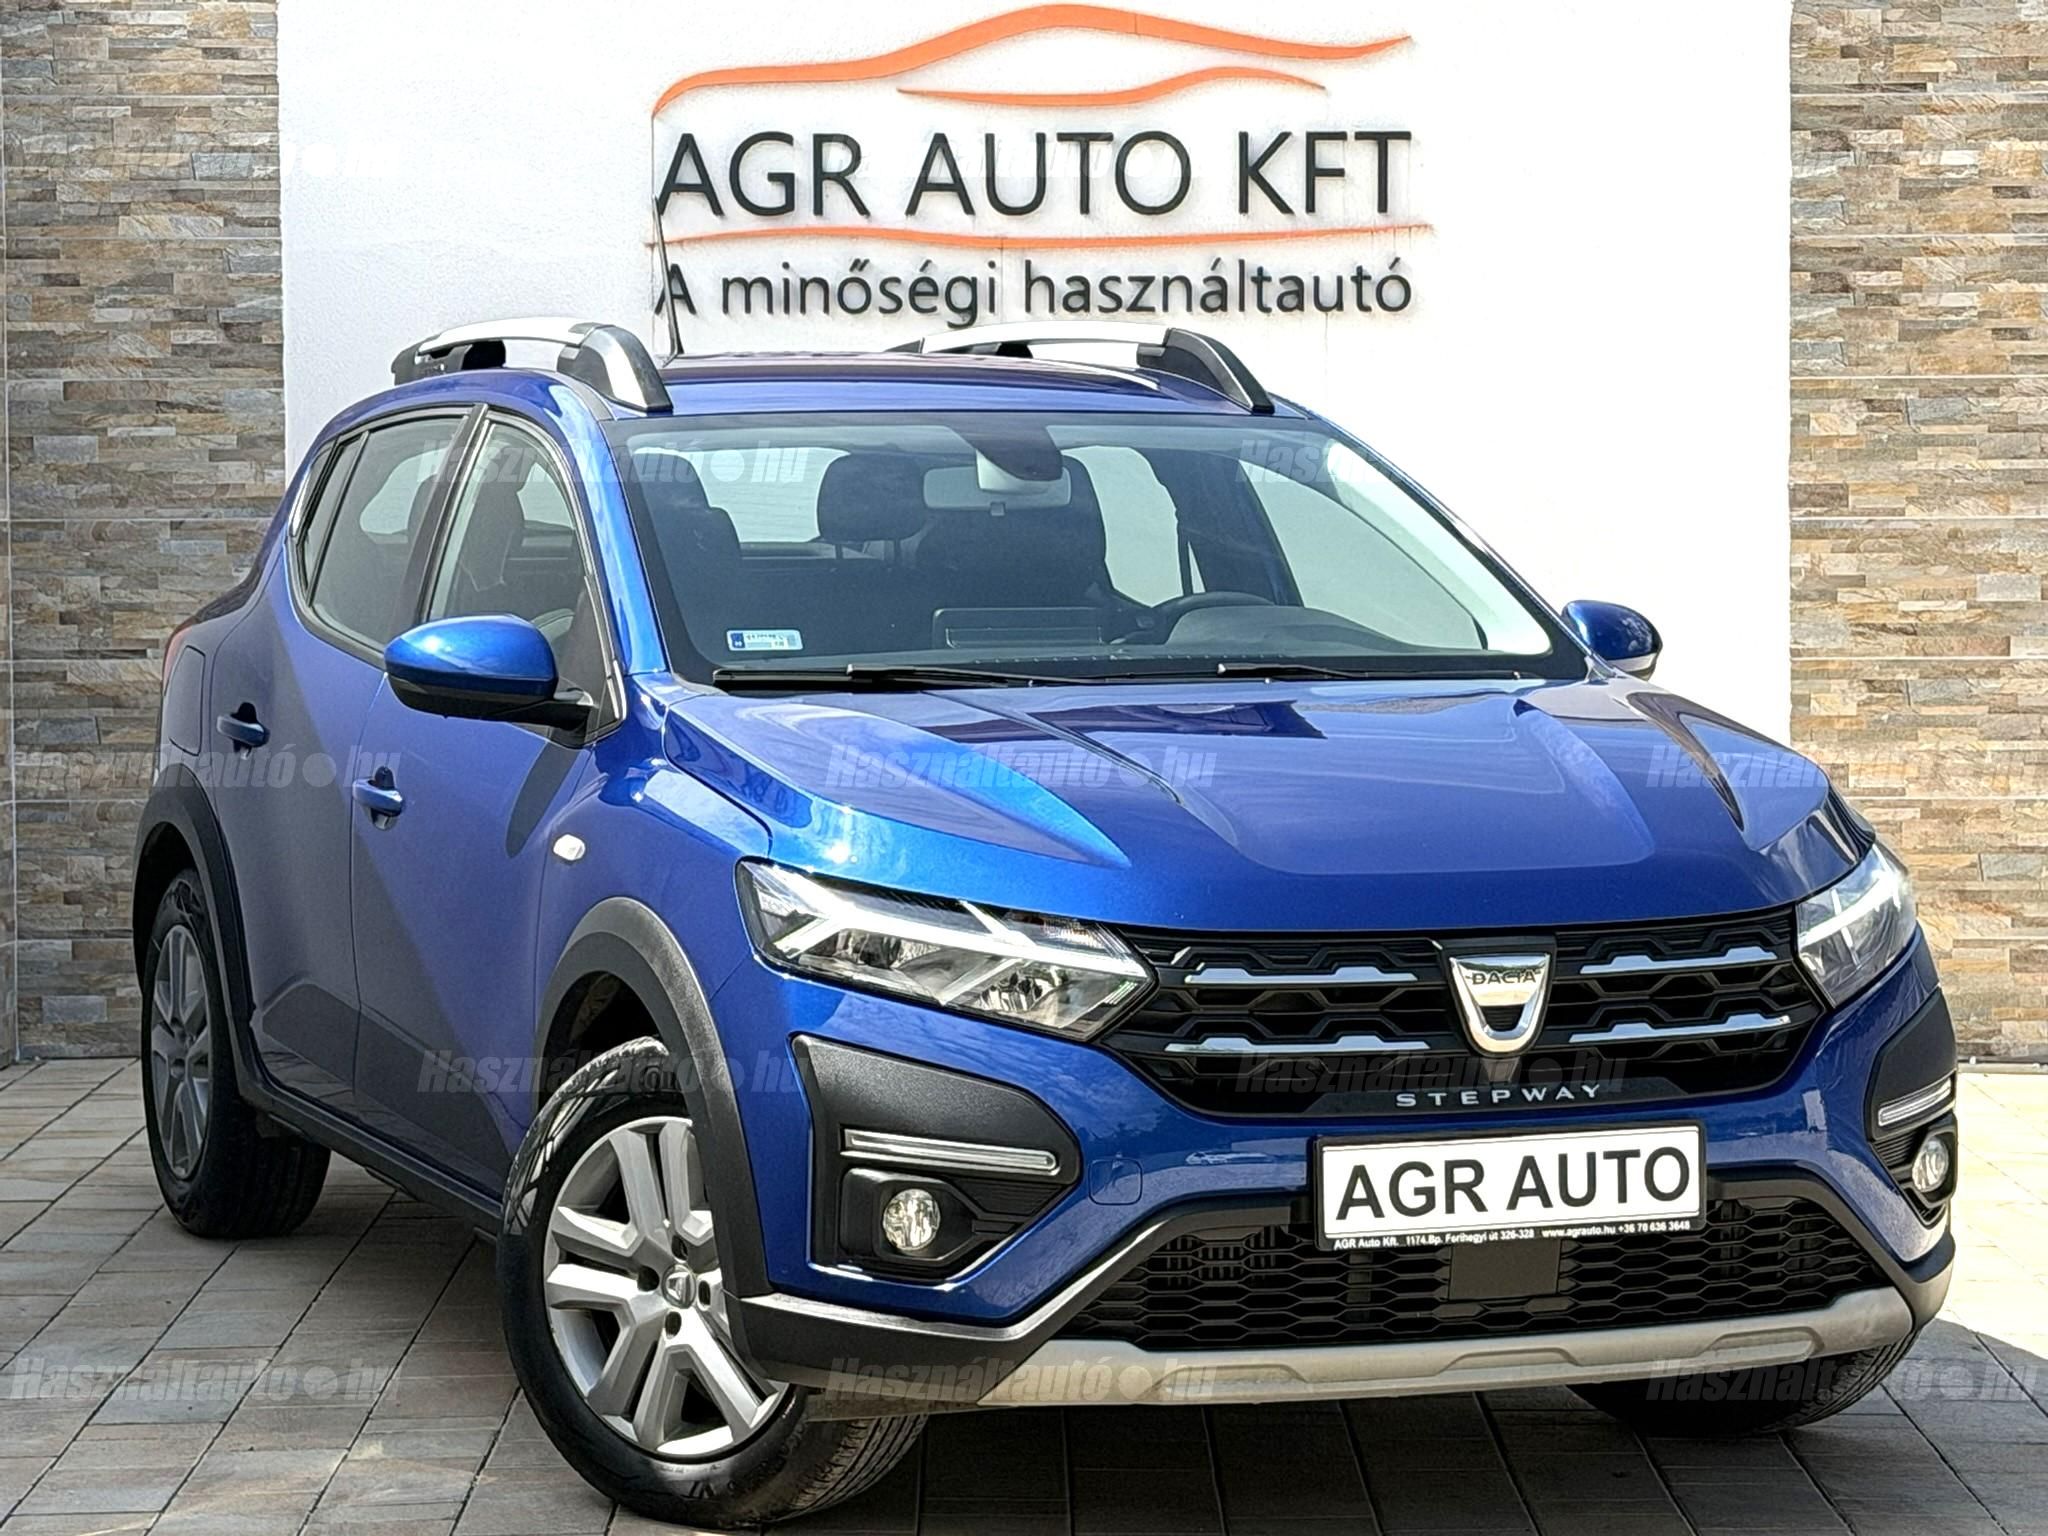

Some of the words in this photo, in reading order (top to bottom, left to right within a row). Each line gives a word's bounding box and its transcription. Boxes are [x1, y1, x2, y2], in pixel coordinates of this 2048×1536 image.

[658, 130, 871, 217] AGR
[904, 129, 1192, 217] AUTO
[1237, 130, 1413, 216] KFT
[653, 263, 698, 316] A
[720, 258, 997, 329] minőségi
[1023, 257, 1414, 316] használtautó
[1471, 967, 1537, 986] DACIA
[1395, 1083, 1602, 1108] STEPWAY
[1335, 1158, 1489, 1221] AGR
[1505, 1146, 1691, 1211] AUTO
[1333, 1238, 1356, 1250] AGR
[1358, 1237, 1381, 1249] Auto
[1542, 1224, 1616, 1239] www.agrauto.hu
[1618, 1222, 1636, 1234] +36
